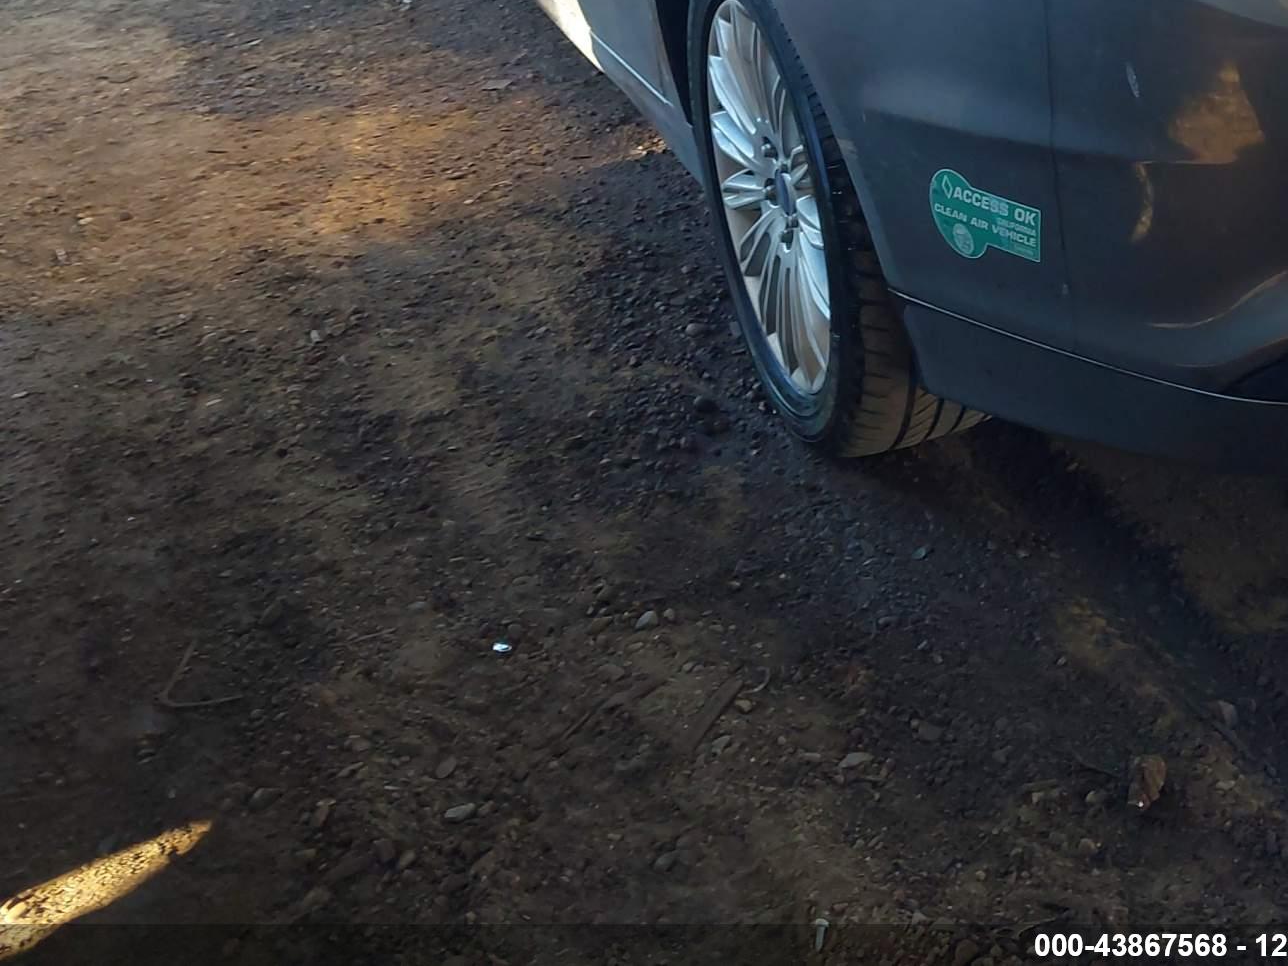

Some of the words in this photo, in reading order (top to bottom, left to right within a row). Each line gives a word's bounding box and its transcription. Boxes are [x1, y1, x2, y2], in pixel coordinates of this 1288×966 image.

[934, 203, 967, 222] CLEAN
[970, 217, 988, 230] AIR
[992, 224, 1037, 247] VEHICLE
[953, 187, 1008, 216] ACCESS
[1014, 208, 1036, 226] OK
